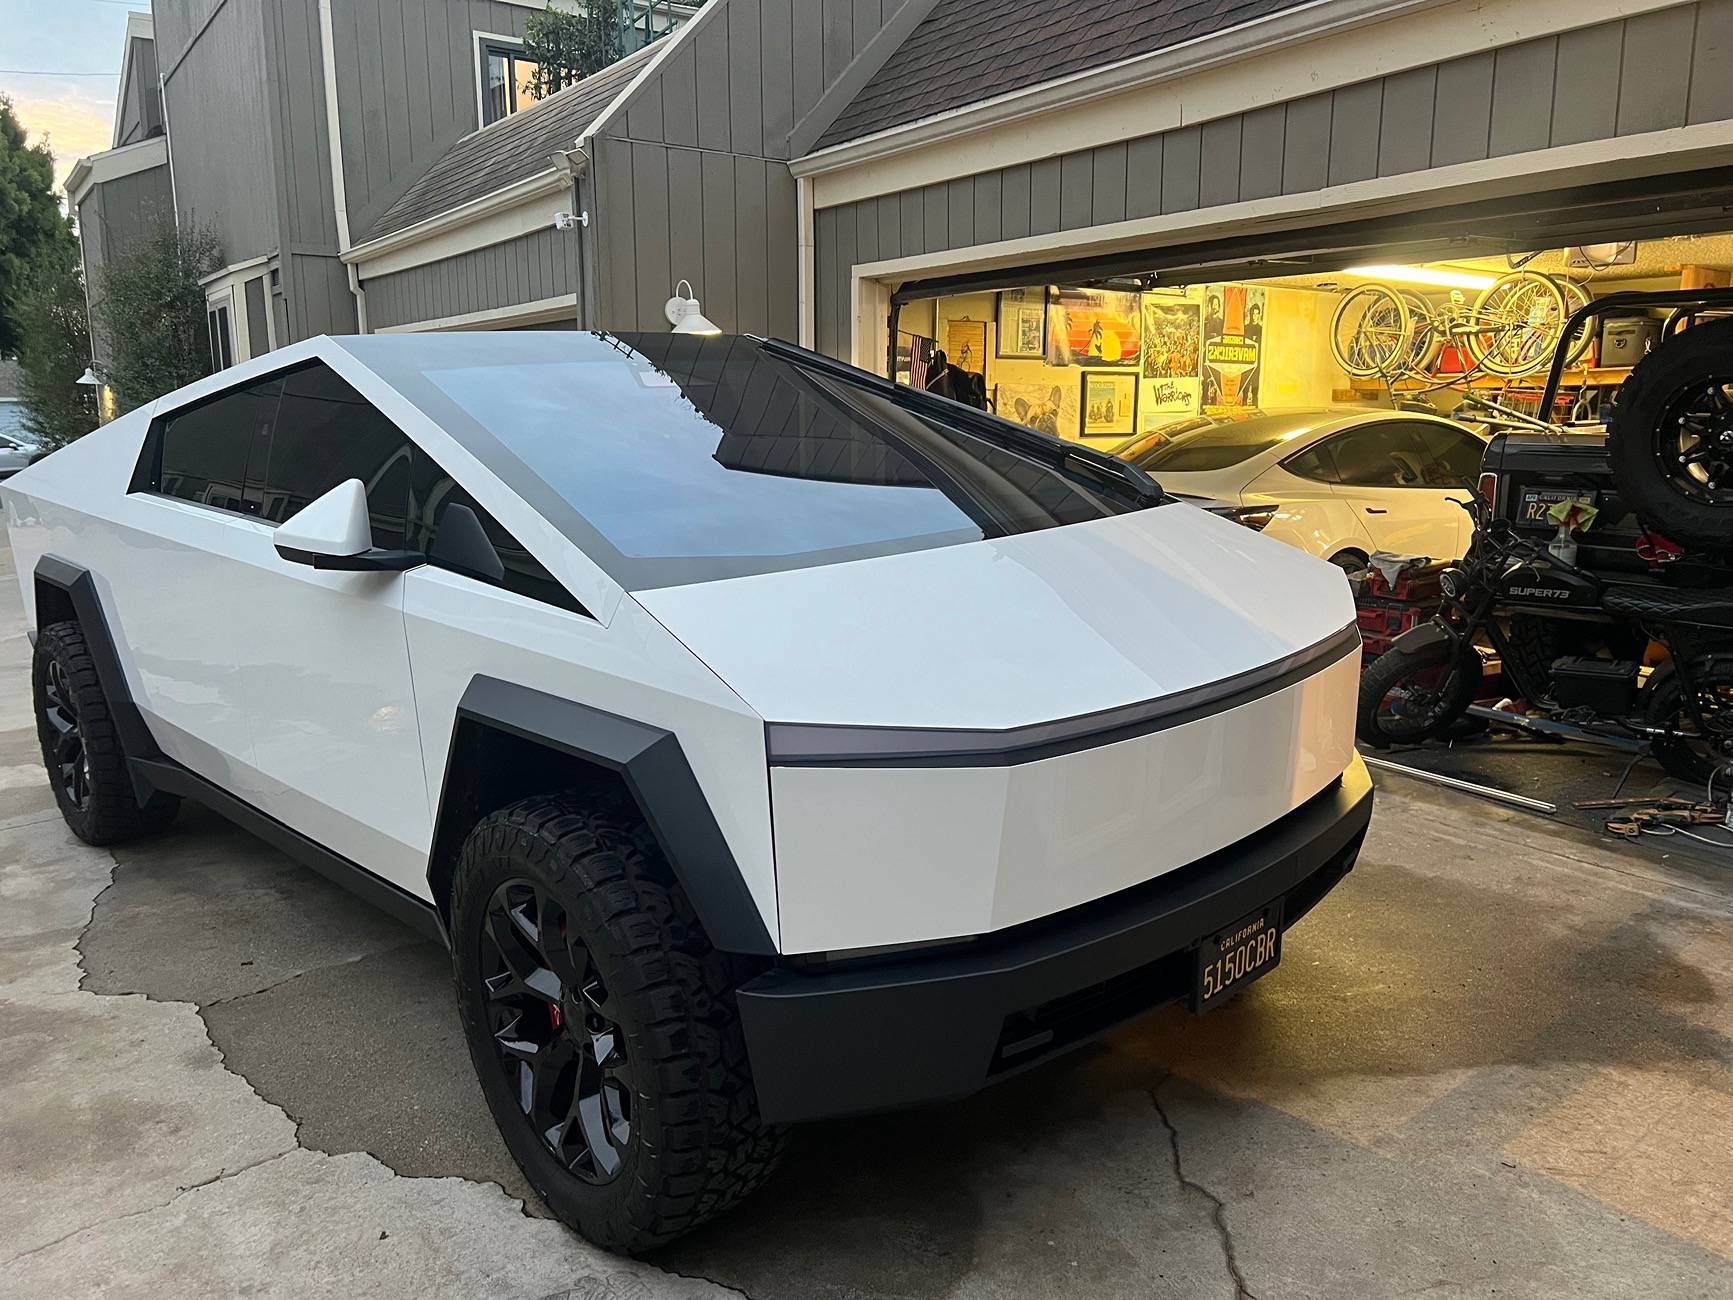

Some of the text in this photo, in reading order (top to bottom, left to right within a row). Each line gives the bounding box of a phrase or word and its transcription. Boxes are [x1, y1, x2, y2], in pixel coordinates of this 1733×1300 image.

[1509, 587, 1569, 598] SUPER73
[1220, 918, 1264, 951] CALIFORNIA
[1203, 928, 1276, 999] 5150CBR
